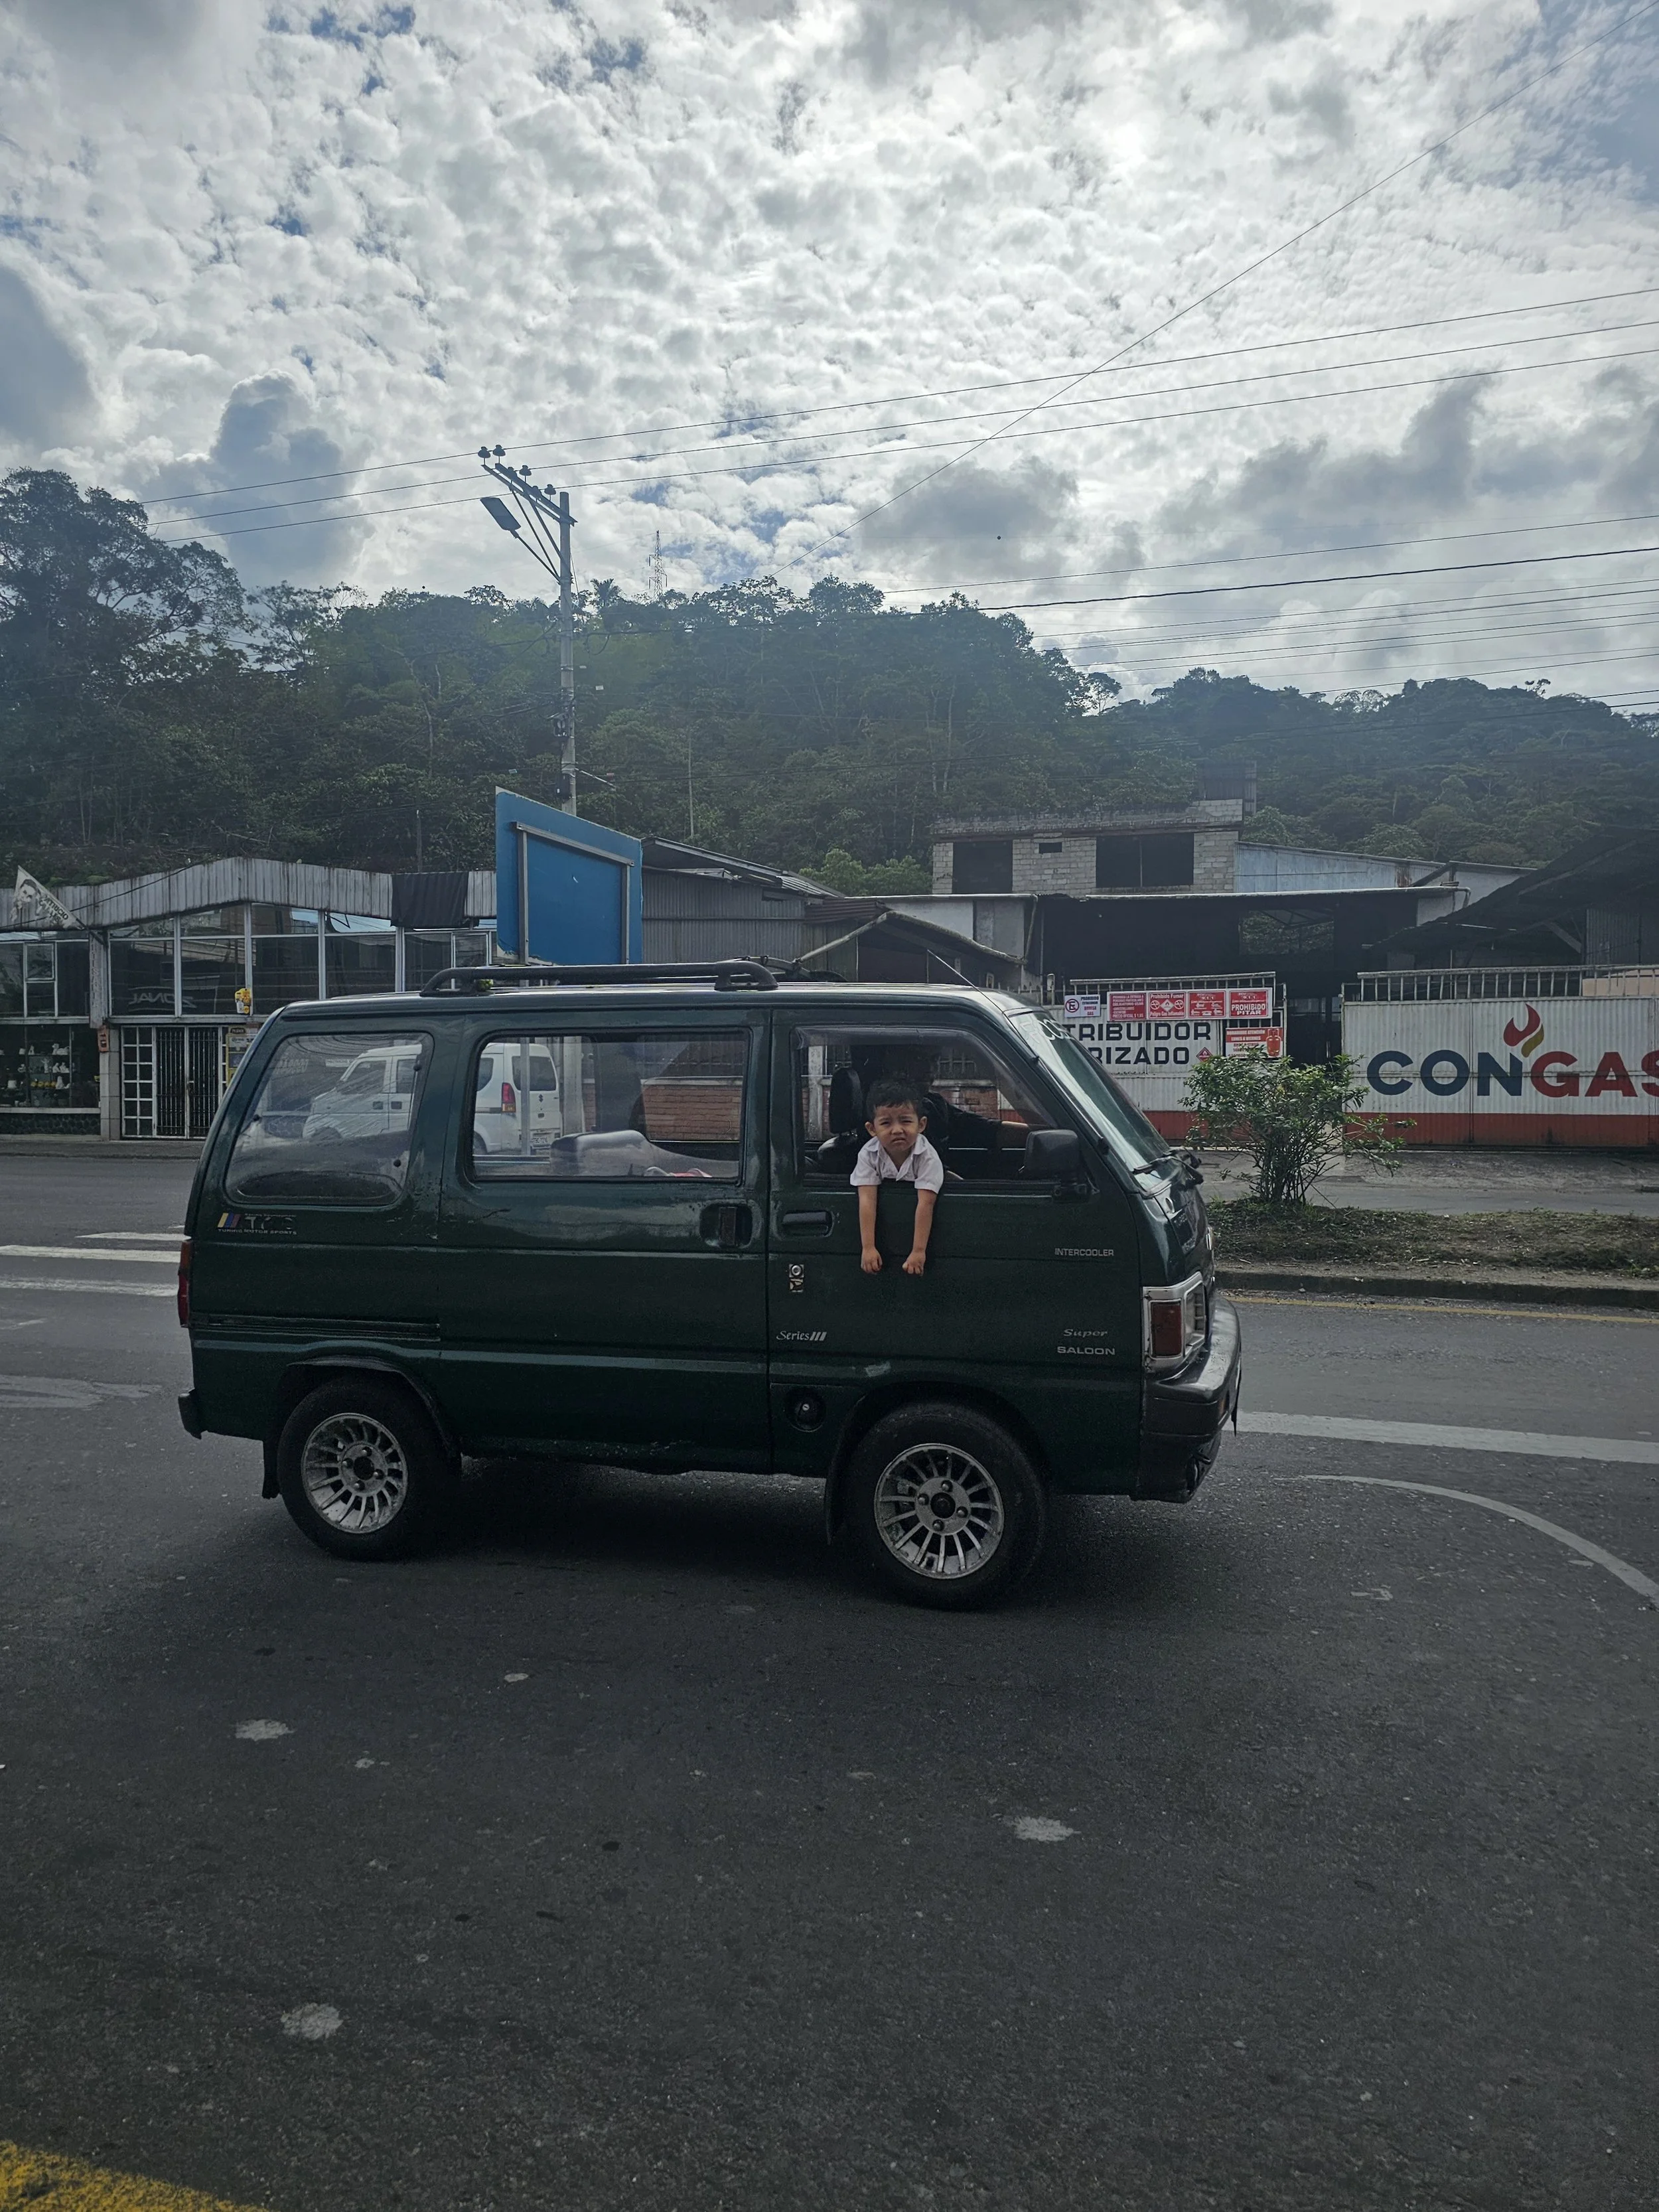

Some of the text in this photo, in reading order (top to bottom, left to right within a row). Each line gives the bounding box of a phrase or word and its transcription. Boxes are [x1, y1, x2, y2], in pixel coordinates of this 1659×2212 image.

[1054, 1248, 1114, 1256] INTERCOOLER
[776, 1331, 809, 1341] Series
[1063, 1329, 1108, 1338] Super
[1057, 1347, 1115, 1355] SALOON
